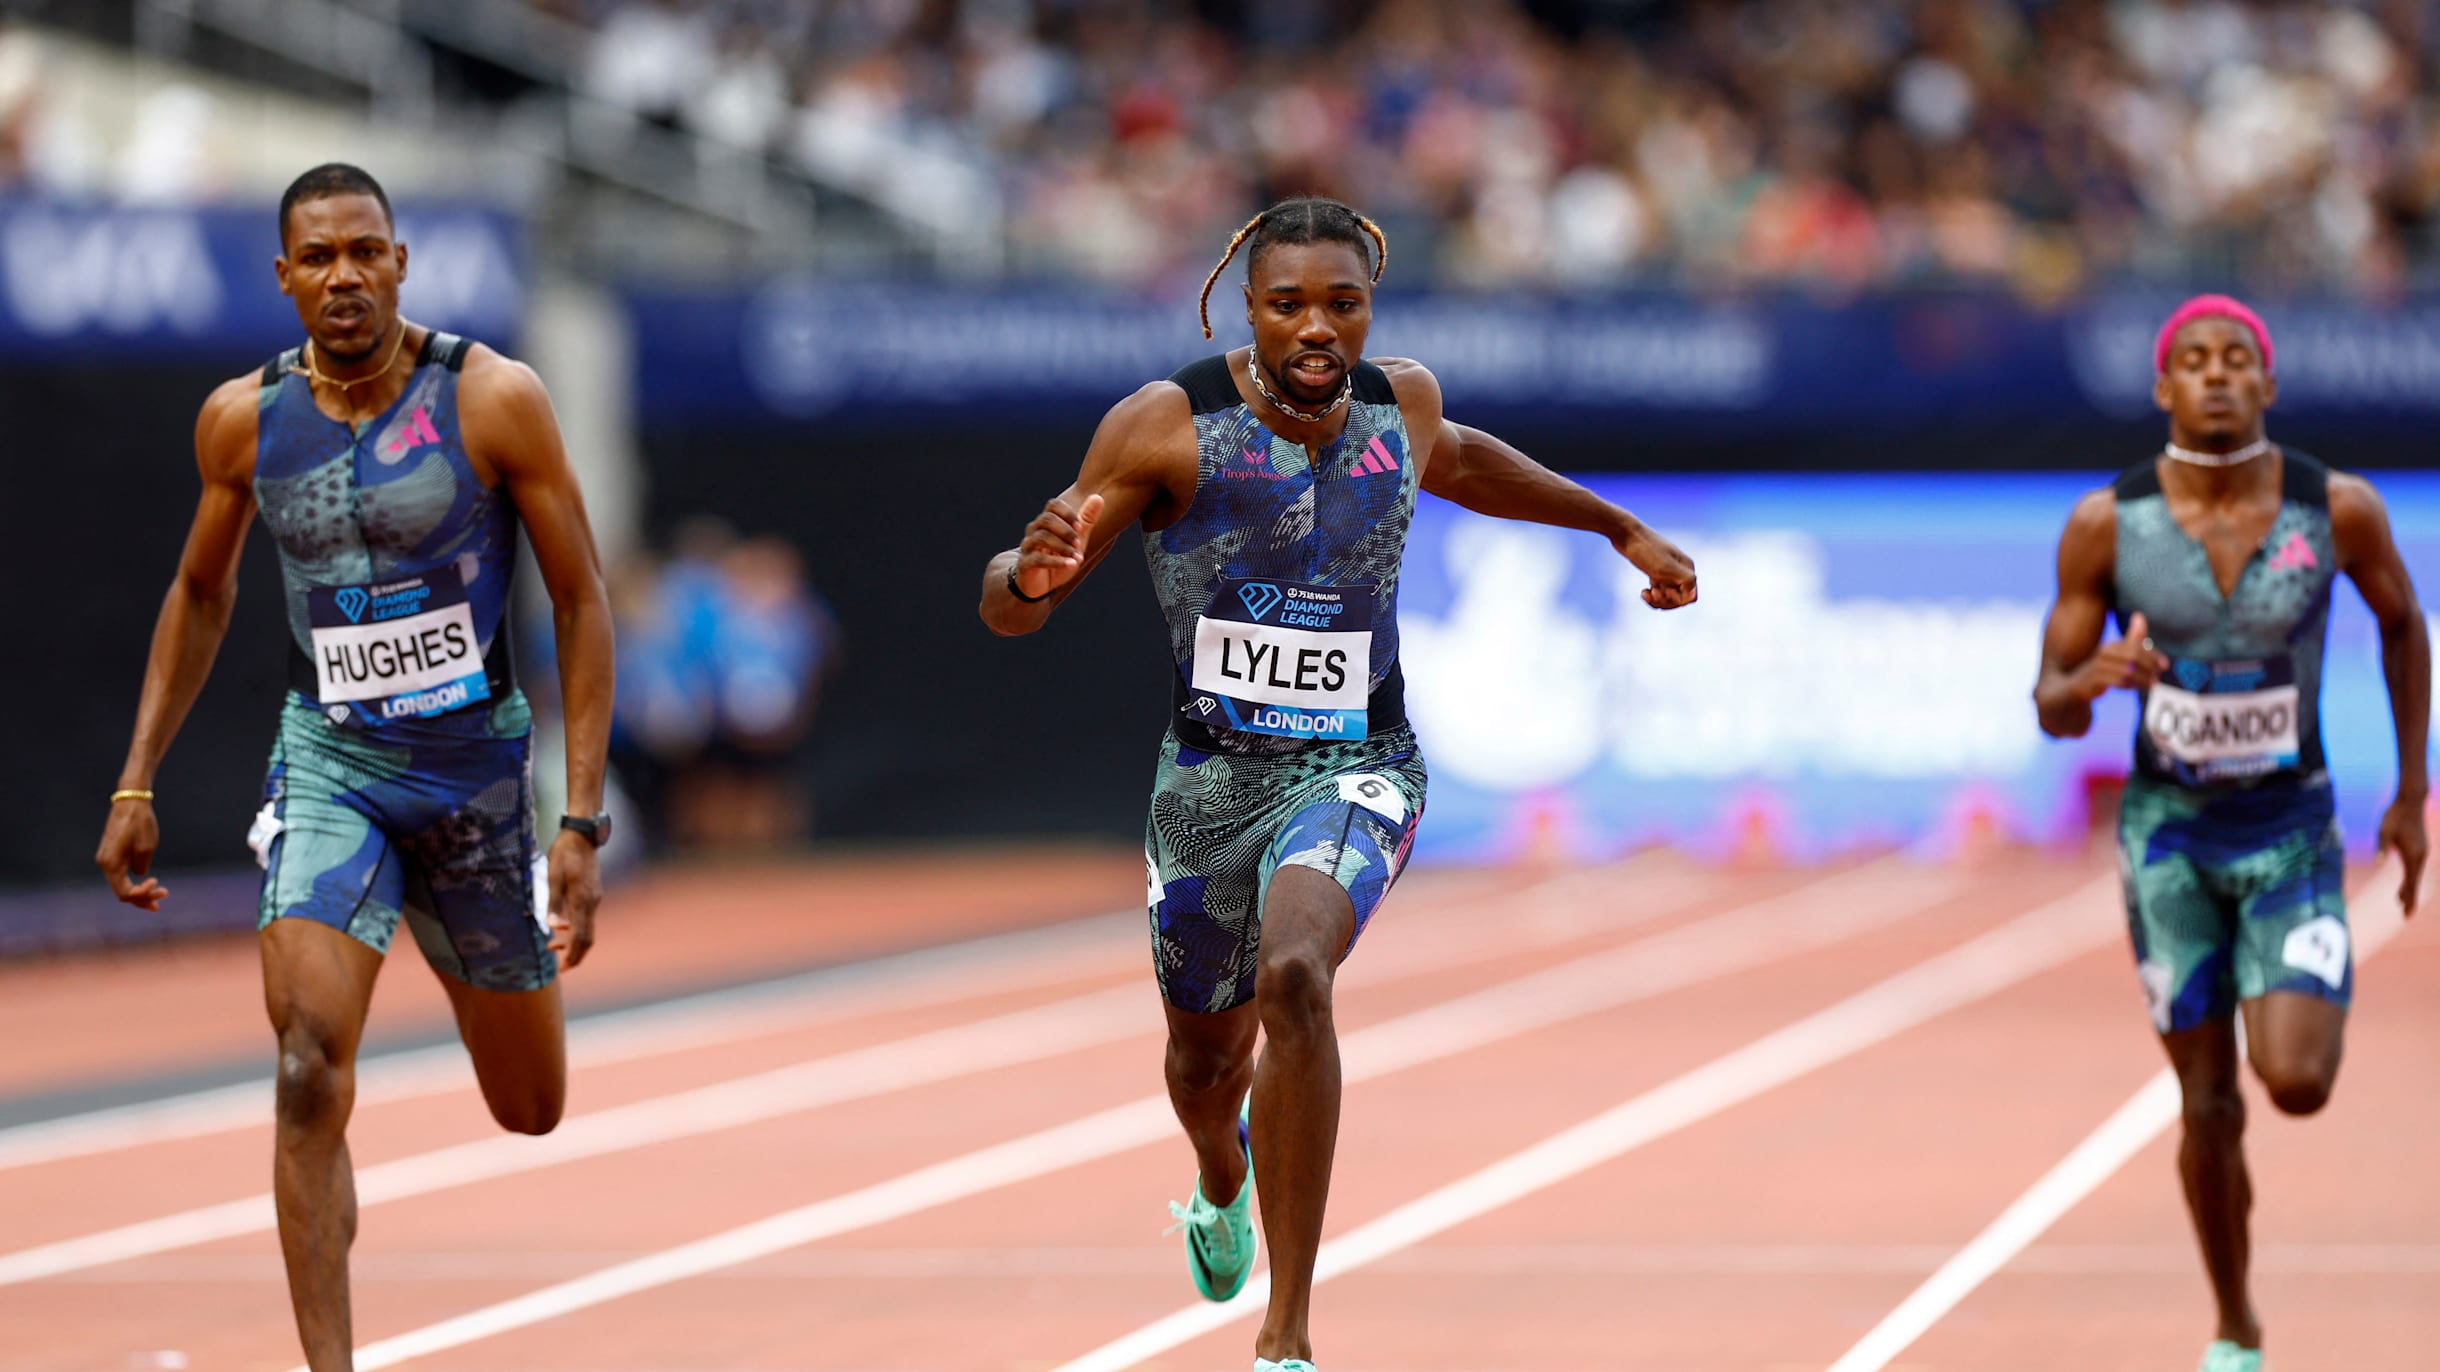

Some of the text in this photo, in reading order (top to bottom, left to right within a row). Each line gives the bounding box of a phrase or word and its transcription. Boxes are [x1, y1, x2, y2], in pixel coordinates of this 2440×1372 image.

[371, 586, 431, 609] DIAMOND
[1284, 599, 1344, 615] DIAMOND
[372, 601, 421, 621] LEAGUE
[1280, 611, 1331, 628] LEAGUE
[324, 621, 467, 684] HUGHES
[1221, 637, 1347, 692] LYLES
[381, 681, 468, 719] LONDON
[1252, 708, 1344, 734] LONDON
[2157, 701, 2289, 746] OGANDO
[1357, 780, 1388, 799] 6
